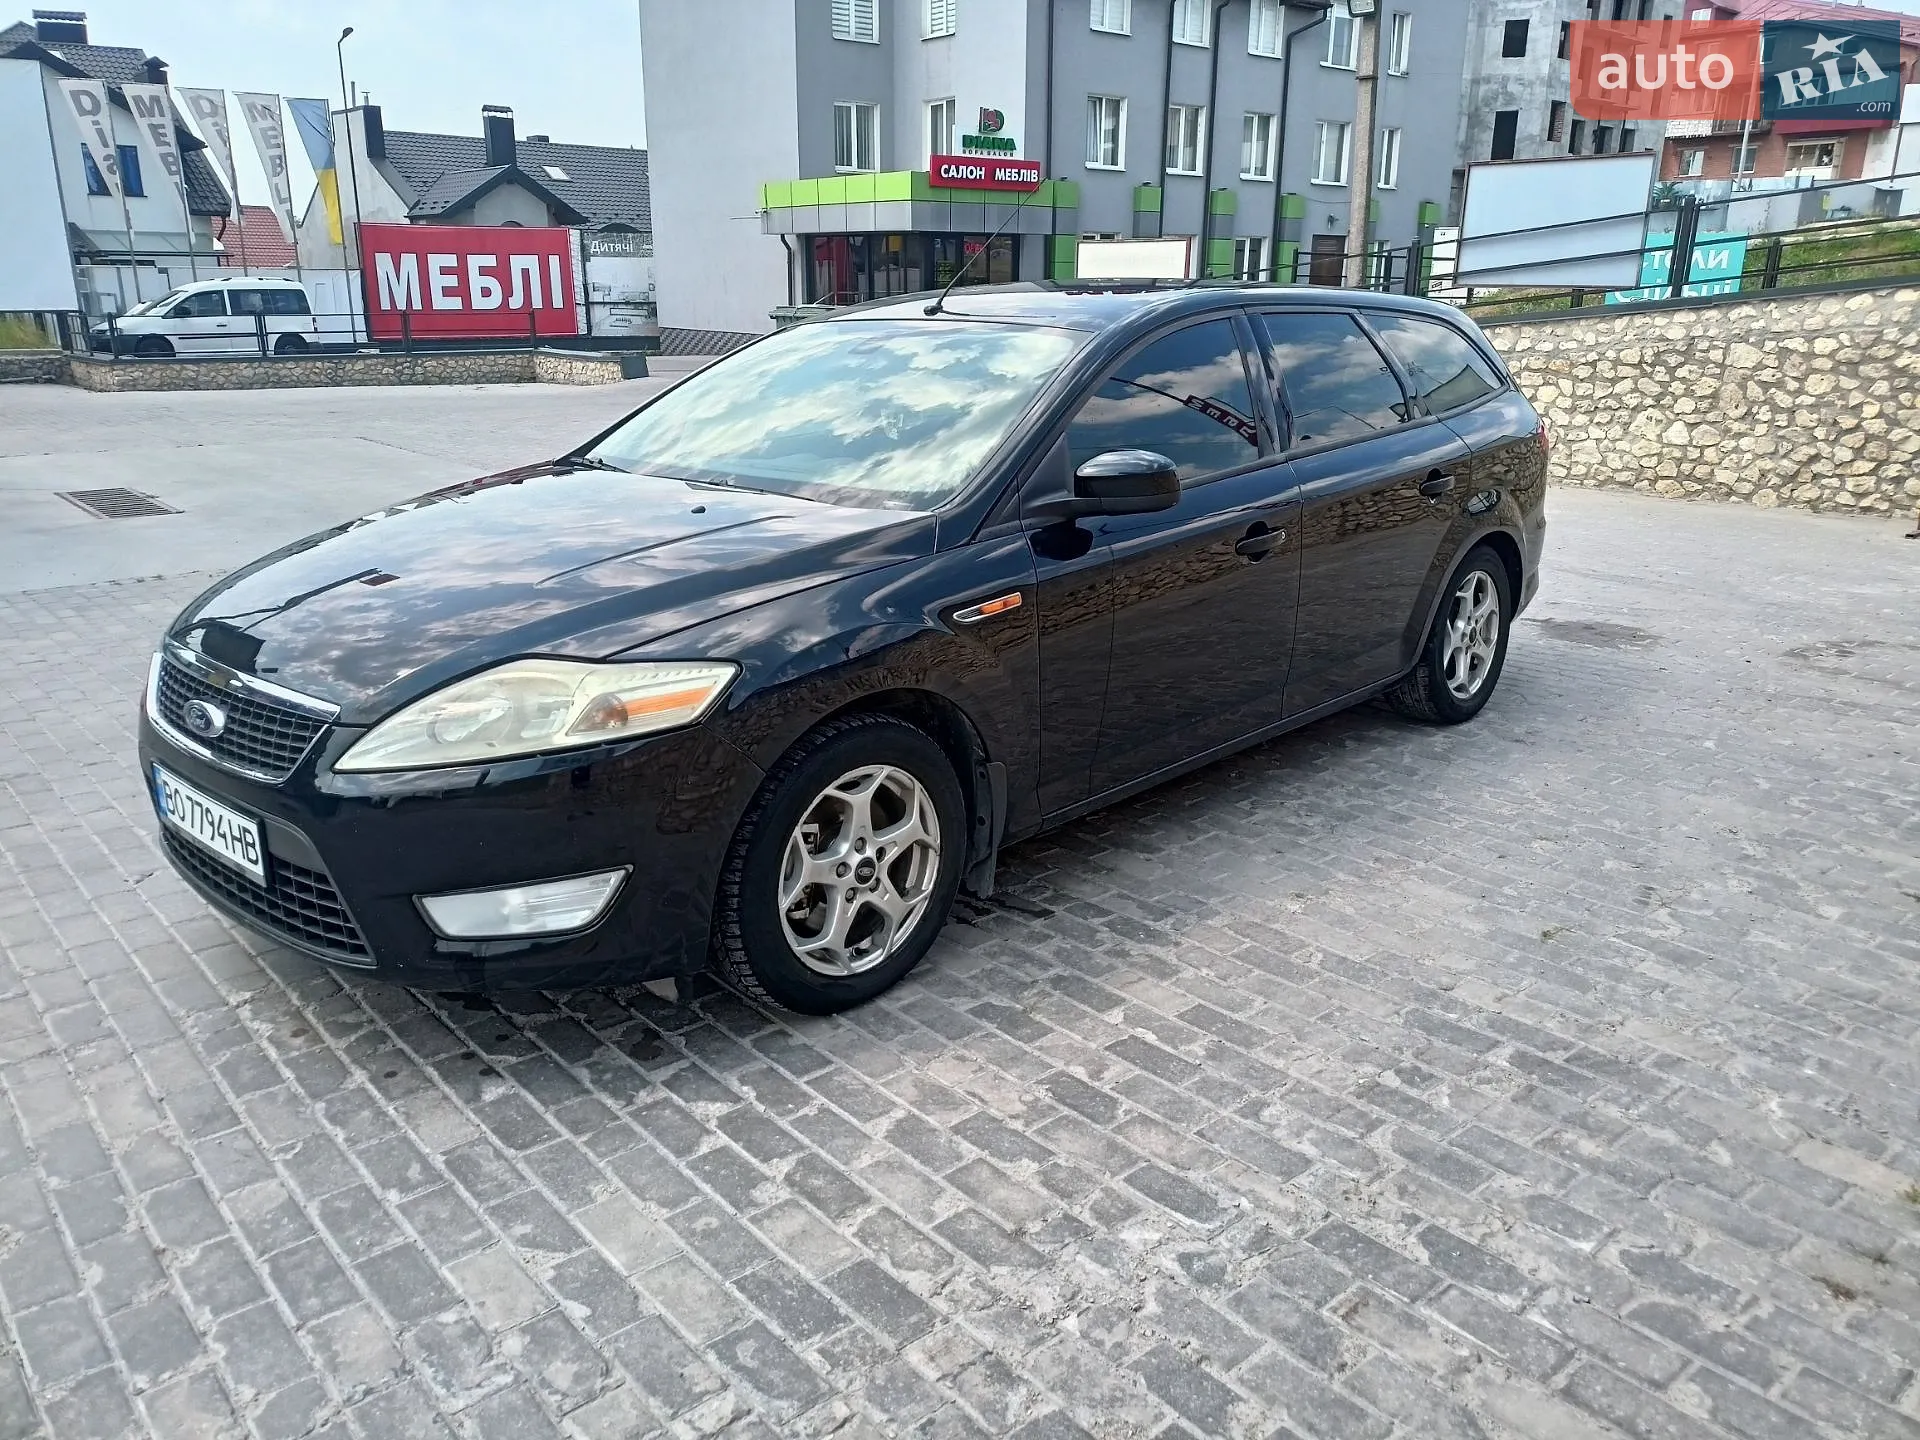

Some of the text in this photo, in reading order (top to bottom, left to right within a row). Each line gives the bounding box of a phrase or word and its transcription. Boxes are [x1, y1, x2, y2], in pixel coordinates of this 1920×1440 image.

[962, 134, 1016, 150] DIANA
[941, 164, 1039, 182] САЛОН МЕБЛІВ
[590, 240, 633, 254] Дитячі
[374, 252, 564, 311] МЕБЛІ
[162, 778, 259, 866] BO7794HB
